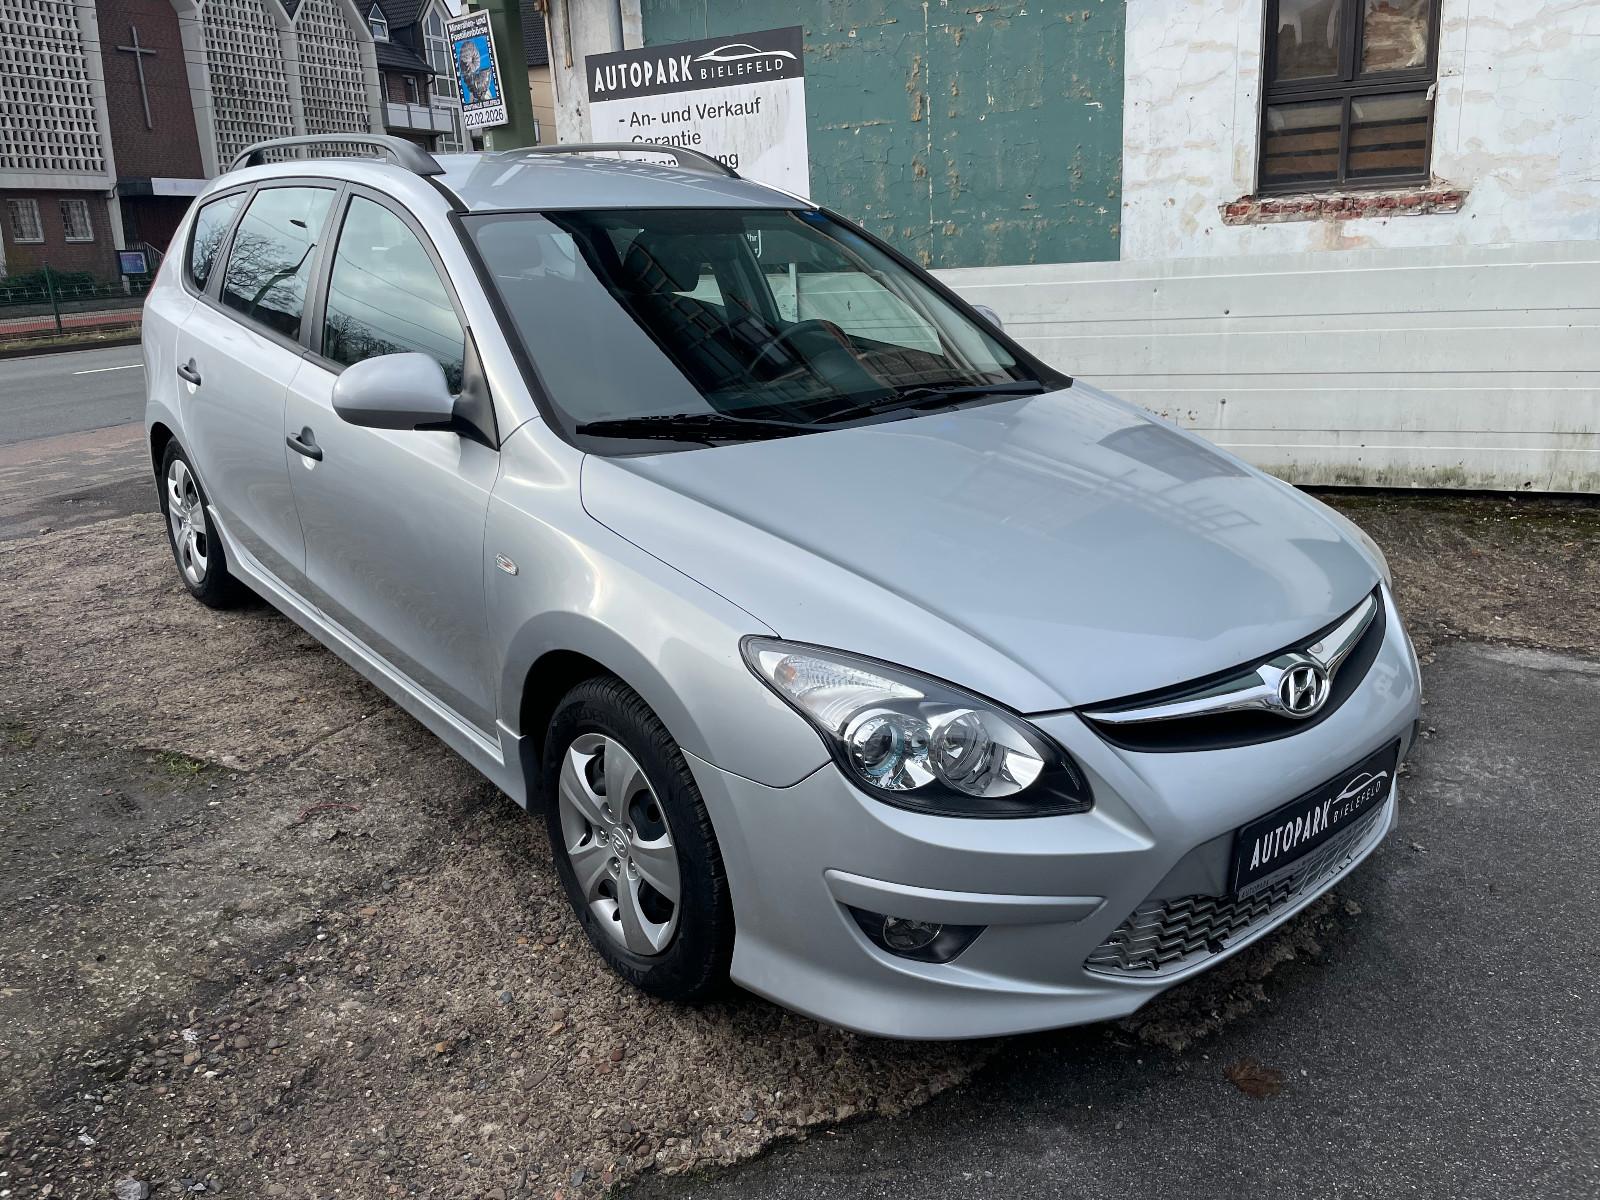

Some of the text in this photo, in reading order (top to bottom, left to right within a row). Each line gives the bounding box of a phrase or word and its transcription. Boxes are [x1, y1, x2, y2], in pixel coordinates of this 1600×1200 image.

[476, 16, 487, 26] und
[594, 54, 784, 93] AUTOPARK BIELEFELD
[465, 109, 504, 126] 22.02.2026
[629, 111, 657, 128] An-
[660, 105, 692, 124] und
[695, 96, 762, 120] Verkauf
[1249, 780, 1382, 871] AUTOPARK BIELEFELD
